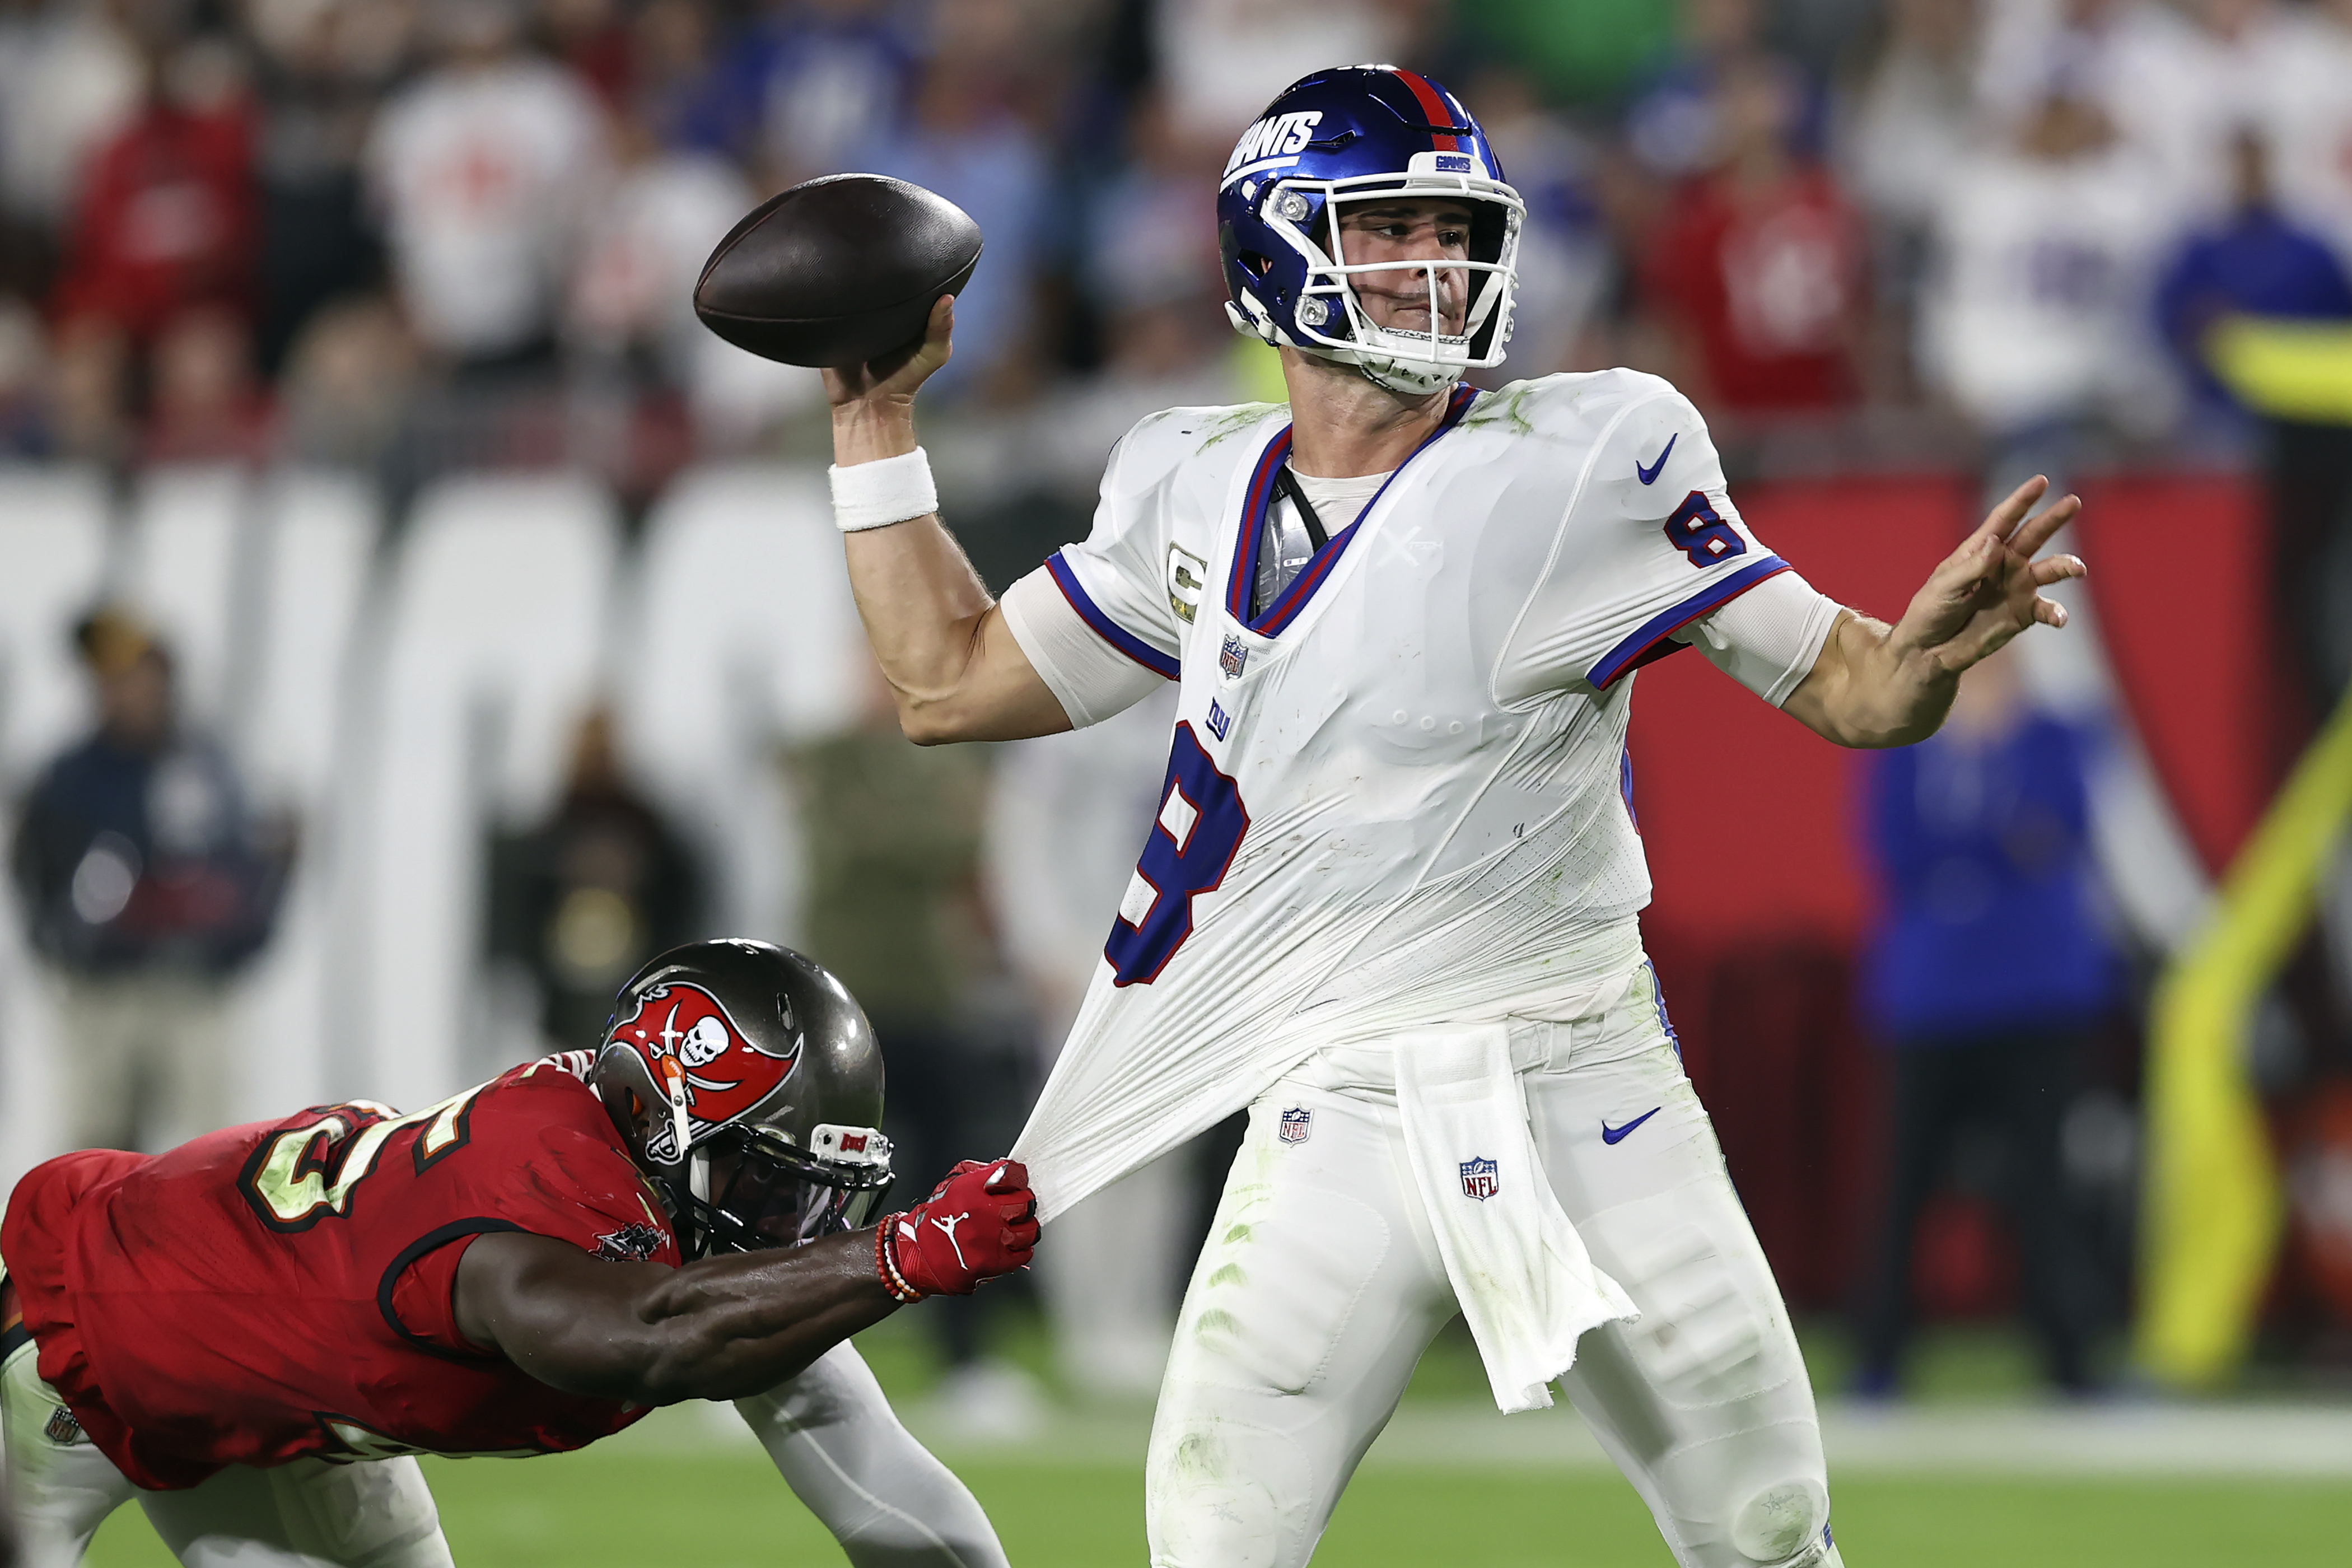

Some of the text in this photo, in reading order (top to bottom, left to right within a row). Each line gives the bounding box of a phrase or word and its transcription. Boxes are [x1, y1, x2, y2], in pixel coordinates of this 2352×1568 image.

[1435, 155, 1471, 170] GIANTS
[1664, 491, 1746, 568] 8
[1168, 549, 1204, 606] C
[1221, 650, 1239, 674] NFL
[1104, 720, 1251, 988] 8
[1282, 1122, 1305, 1138] NFL
[236, 1073, 505, 1234] 5
[1465, 1176, 1497, 1197] NFL
